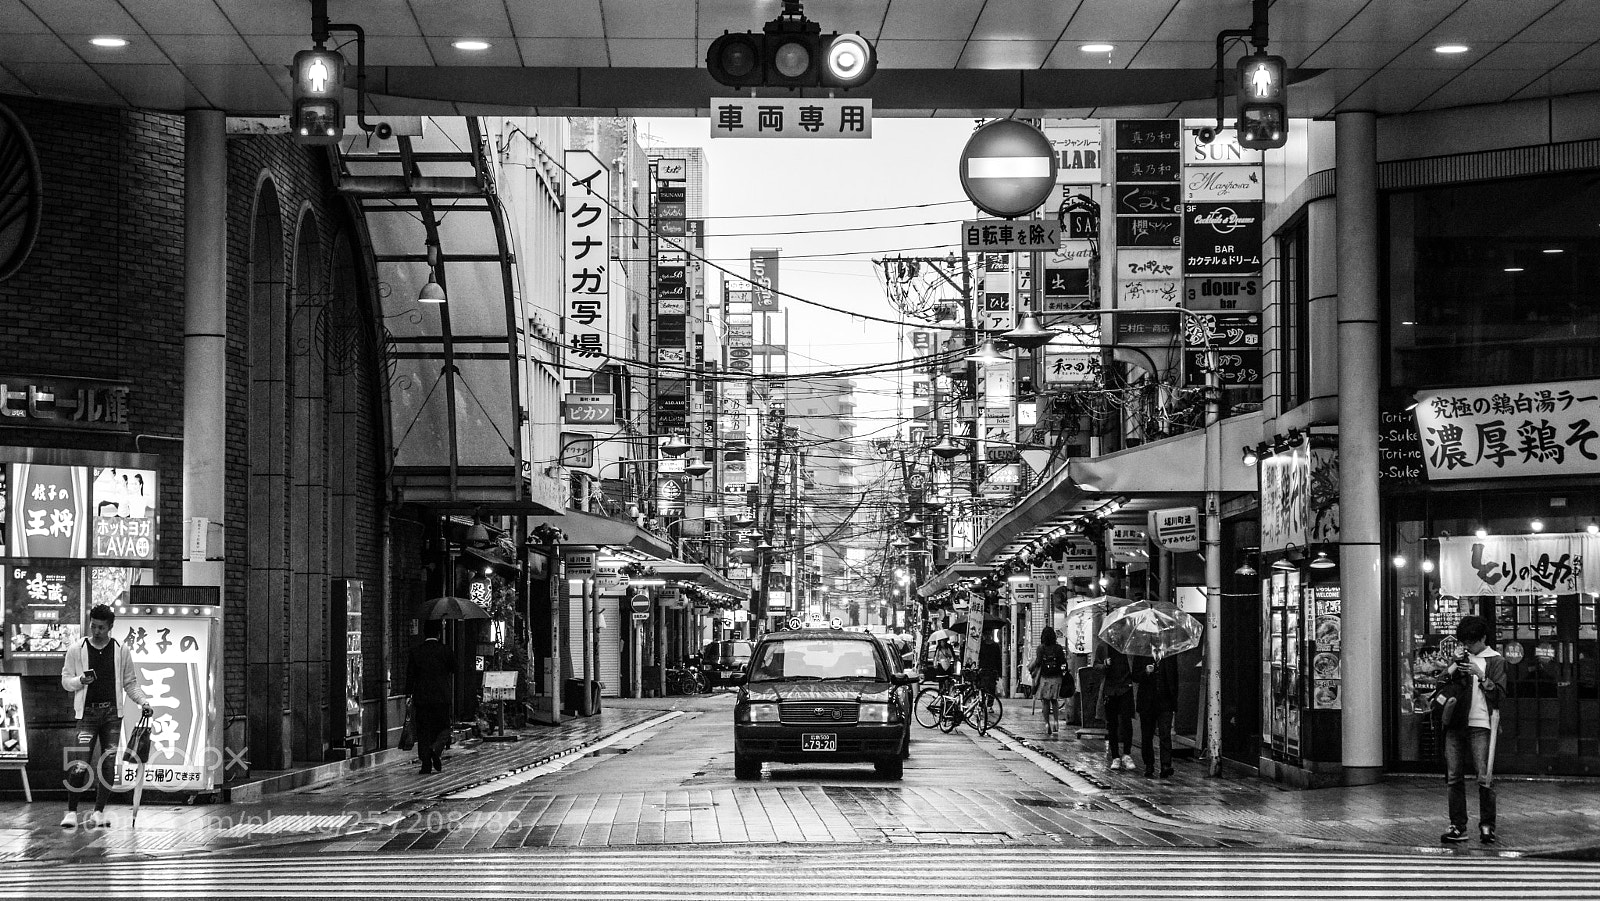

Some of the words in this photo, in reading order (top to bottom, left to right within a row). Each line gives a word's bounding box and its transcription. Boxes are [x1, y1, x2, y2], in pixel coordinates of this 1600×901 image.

[718, 104, 864, 132] 車両専用
[967, 224, 1055, 246] 自転車を除く
[1215, 245, 1234, 253] BAR
[570, 169, 606, 358] イクナガ写場
[1188, 289, 1196, 300] 3
[1202, 279, 1257, 297] dour-s
[1220, 298, 1237, 309] bar
[570, 406, 610, 421] ピカソ
[1431, 390, 1599, 419] 究極の鶏白湯ラー
[1426, 419, 1599, 471] 濃厚鶏そ
[32, 483, 69, 501] 餃子の
[26, 508, 73, 538] 王将
[97, 519, 151, 537] ホットヨガ
[97, 537, 137, 557] LAVA
[13, 568, 27, 579] 6F
[123, 626, 200, 656] 餃子の
[810, 740, 835, 749] 79-20
[124, 768, 202, 783] おち帰りできます
